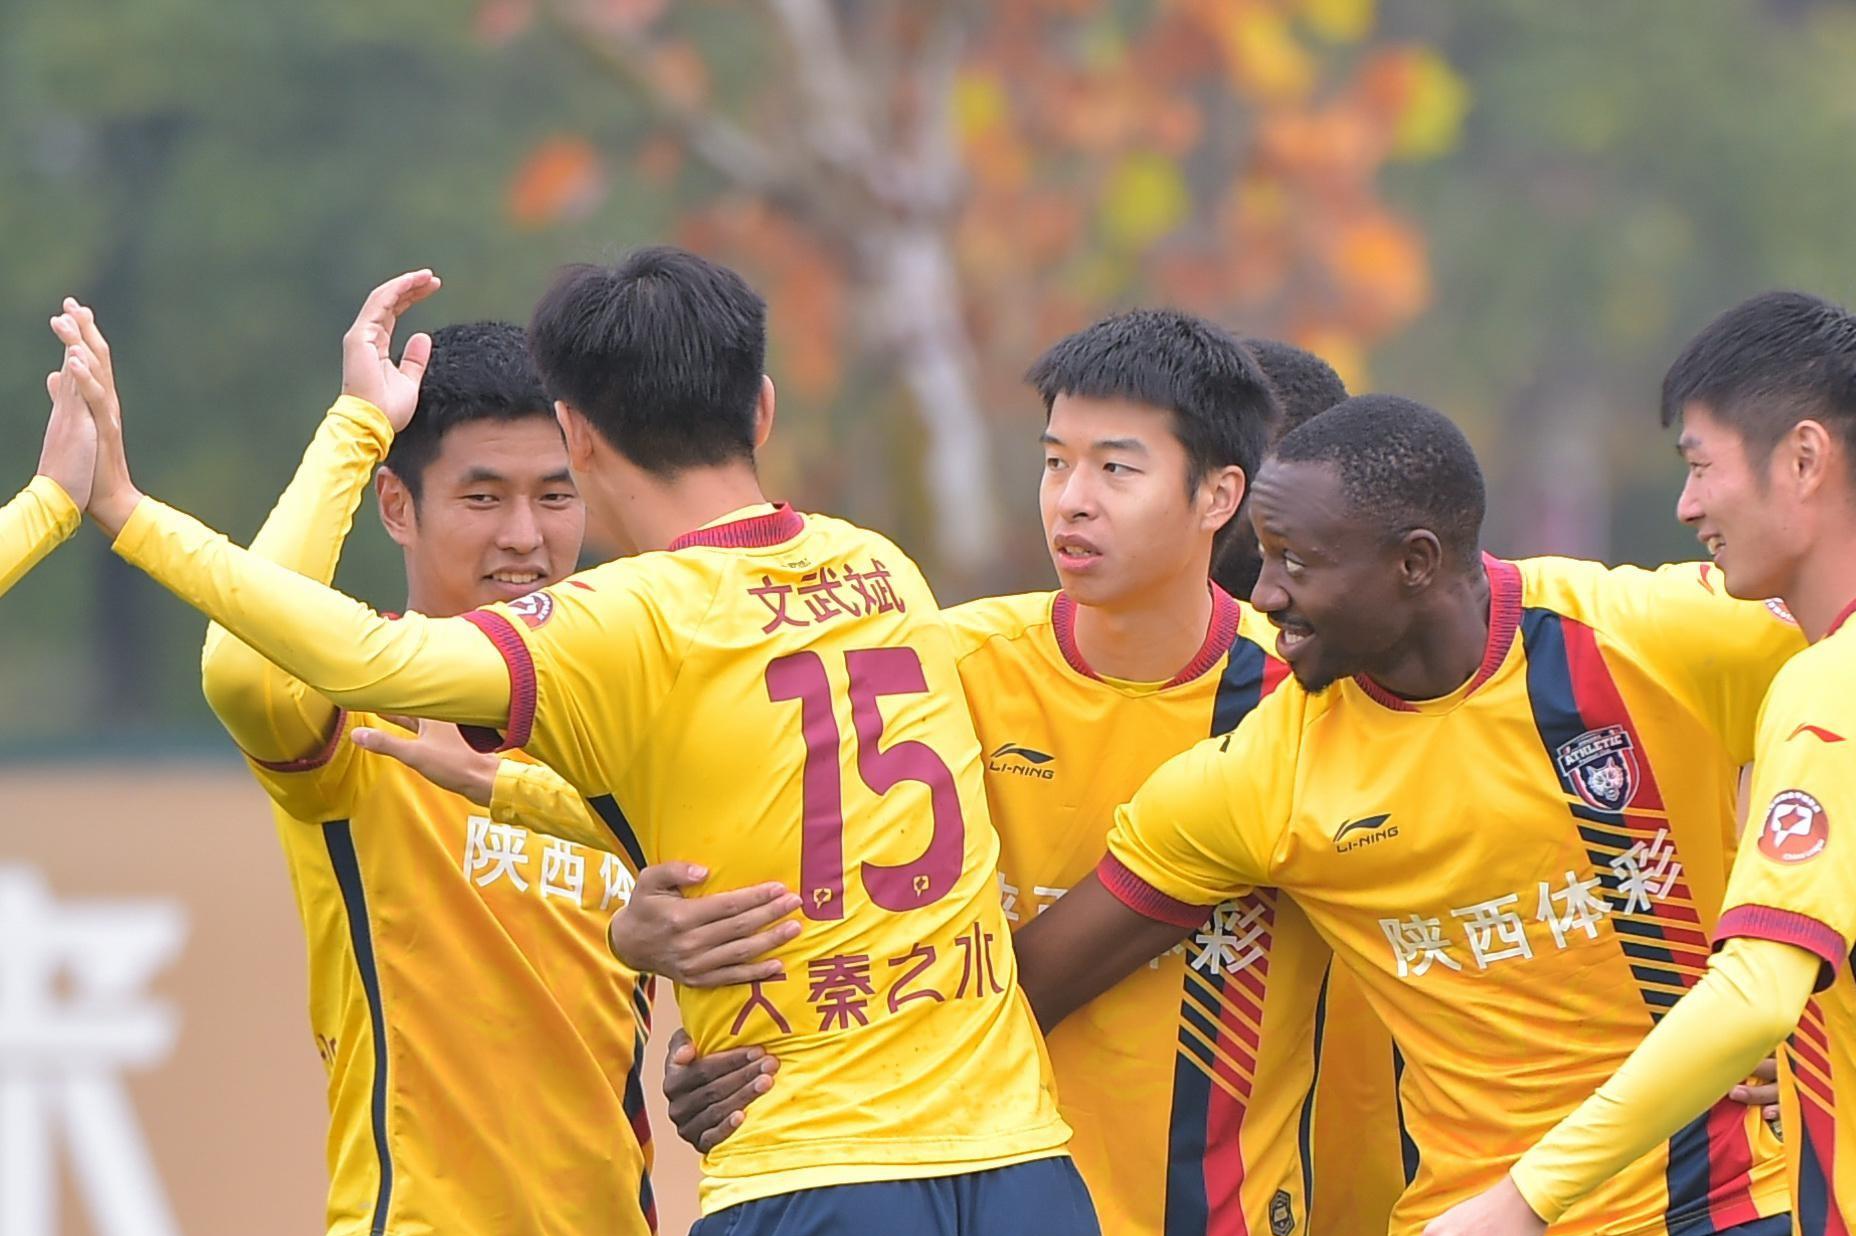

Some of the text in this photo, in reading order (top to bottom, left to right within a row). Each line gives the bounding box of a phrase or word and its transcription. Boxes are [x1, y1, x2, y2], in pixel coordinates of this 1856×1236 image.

[747, 557, 907, 635] 文武斌
[764, 646, 965, 921] 15
[988, 760, 1055, 781] LI-NING
[463, 815, 636, 911] 陕西体
[1336, 826, 1399, 854] LI-NING
[1378, 828, 1682, 977] 陕西体彩
[730, 922, 1005, 1036] 大秦之水
